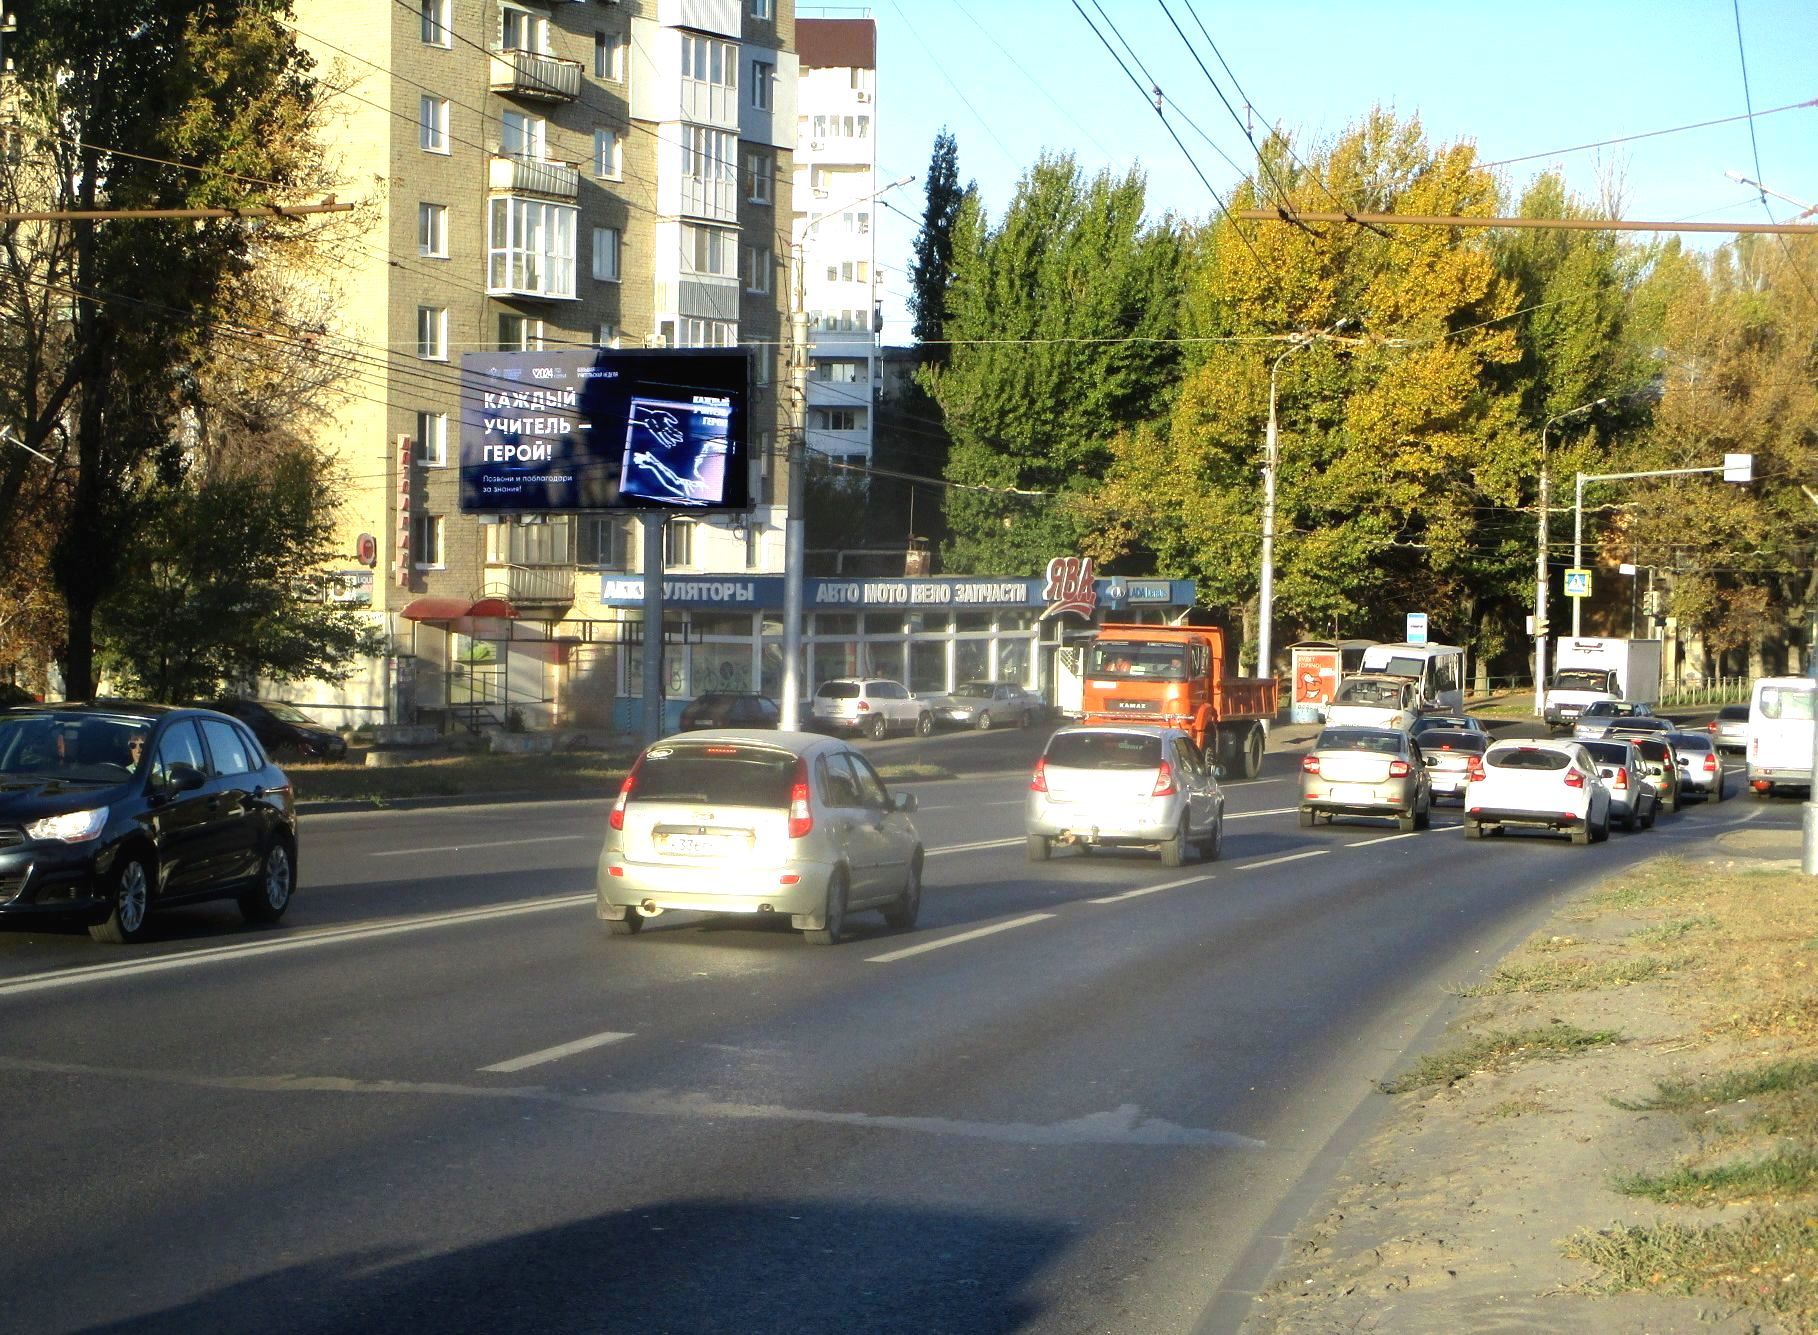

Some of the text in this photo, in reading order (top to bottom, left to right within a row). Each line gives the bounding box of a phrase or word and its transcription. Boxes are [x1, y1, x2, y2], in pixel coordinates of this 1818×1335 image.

[484, 387, 576, 411] КАЖДЫЙ
[484, 418, 571, 434] УЧИТЕЛЬ
[483, 440, 552, 462] ГЕРОЙ!
[523, 475, 573, 484] поблагодари
[604, 580, 755, 601] АККУЛЯТОРЫ
[816, 583, 1027, 603] АВТО МОТО ВЕЛО ЗАПЧАСТИ
